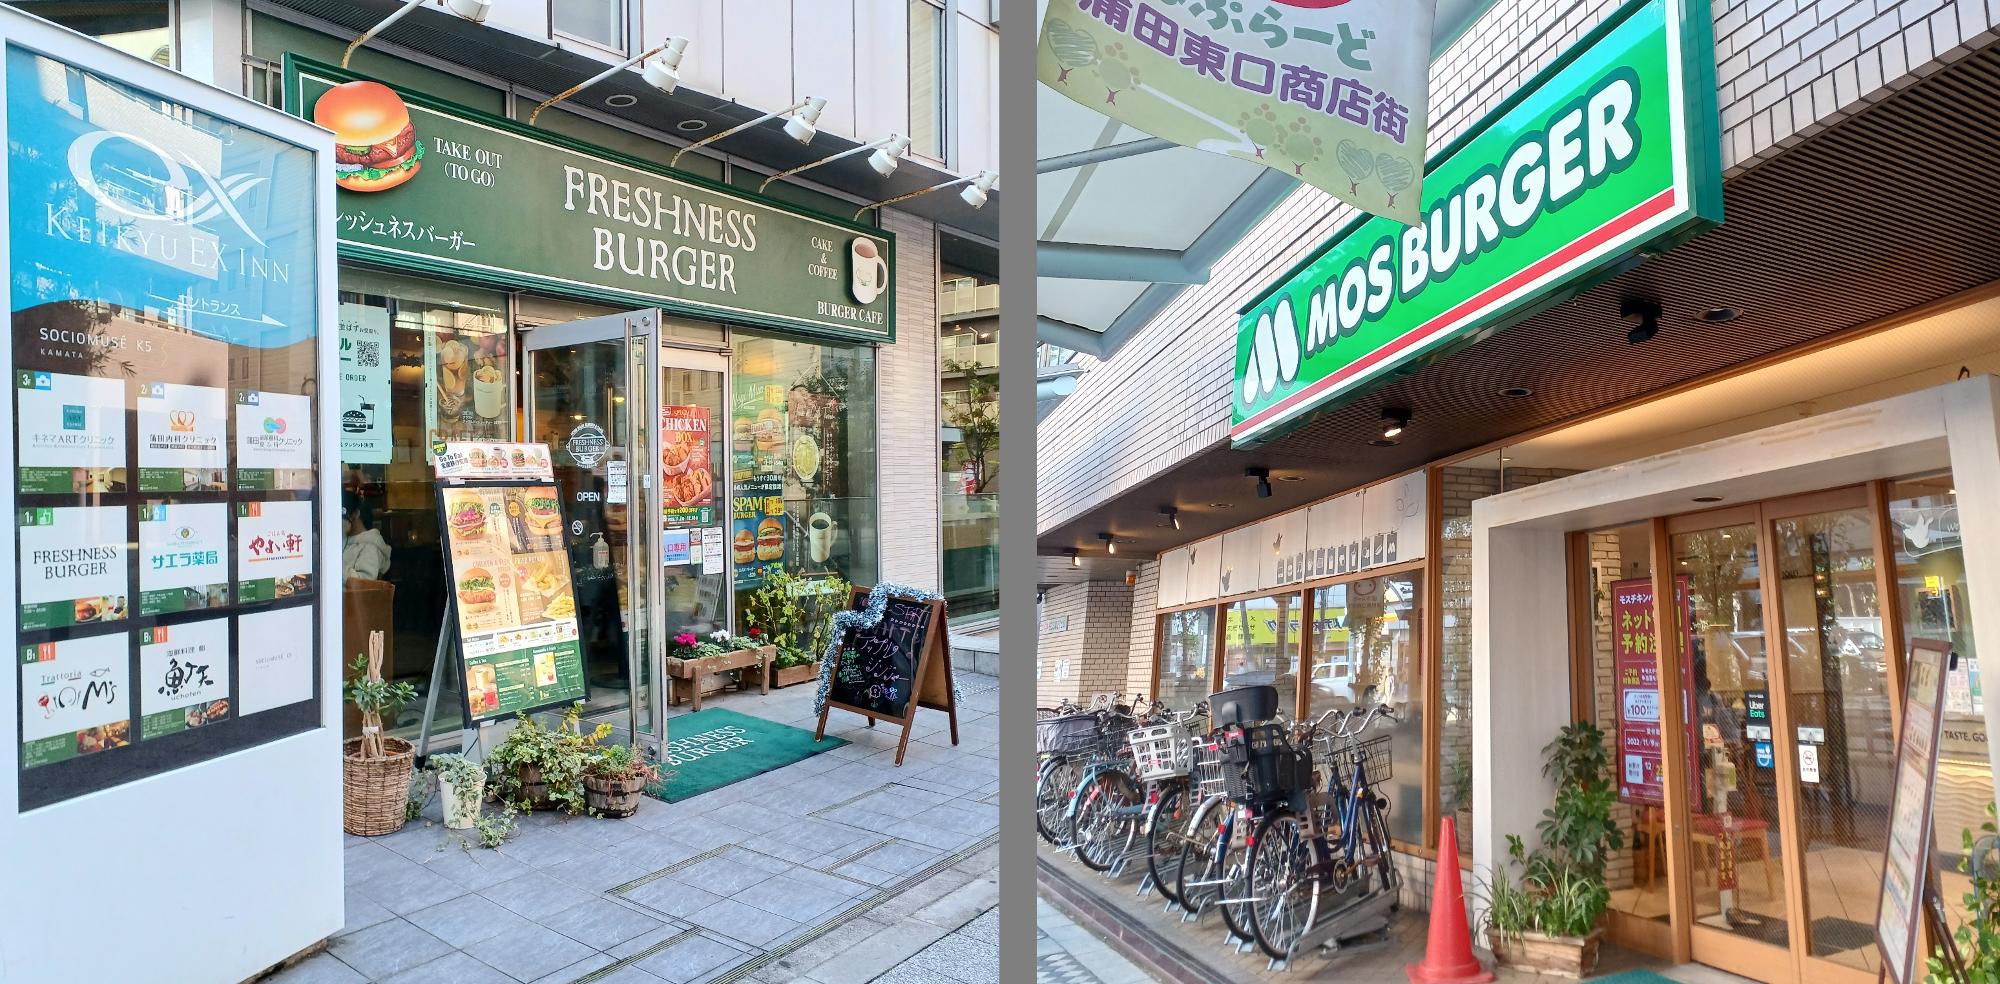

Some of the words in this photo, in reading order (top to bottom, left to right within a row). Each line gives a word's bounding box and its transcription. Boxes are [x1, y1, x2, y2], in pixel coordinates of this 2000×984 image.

[434, 137, 472, 161] TAKE
[475, 148, 503, 169] OUT
[445, 162, 469, 180] (TO
[471, 168, 495, 188] GO)
[563, 164, 757, 252] FRESHNESS
[1306, 247, 1395, 354] MOS
[1400, 79, 1635, 295] BURGER
[45, 203, 179, 260] KEIKYU
[190, 231, 229, 273] EX
[239, 249, 290, 284] INN
[811, 236, 834, 252] CAKE
[593, 227, 738, 295] BURGER
[820, 252, 828, 264] &
[808, 263, 838, 280] COFFEE
[817, 300, 858, 320] BURGER
[859, 308, 884, 325] CAFE
[40, 347, 83, 359] KAMATA
[136, 339, 153, 353] K5
[345, 373, 367, 382] ORDER
[572, 438, 604, 446] FRESHNESS
[675, 430, 694, 443] BOX
[575, 445, 600, 453] BURGER
[576, 491, 600, 502] OPEN
[733, 496, 764, 512] SPAM
[248, 533, 303, 556] やよい軒
[33, 545, 118, 565] FRESHNESS
[151, 550, 219, 570] サエラ薬局
[45, 562, 108, 580] BURGER
[41, 669, 82, 683] Trattoria
[1749, 701, 1765, 710] Uber
[1749, 709, 1766, 719] Eats
